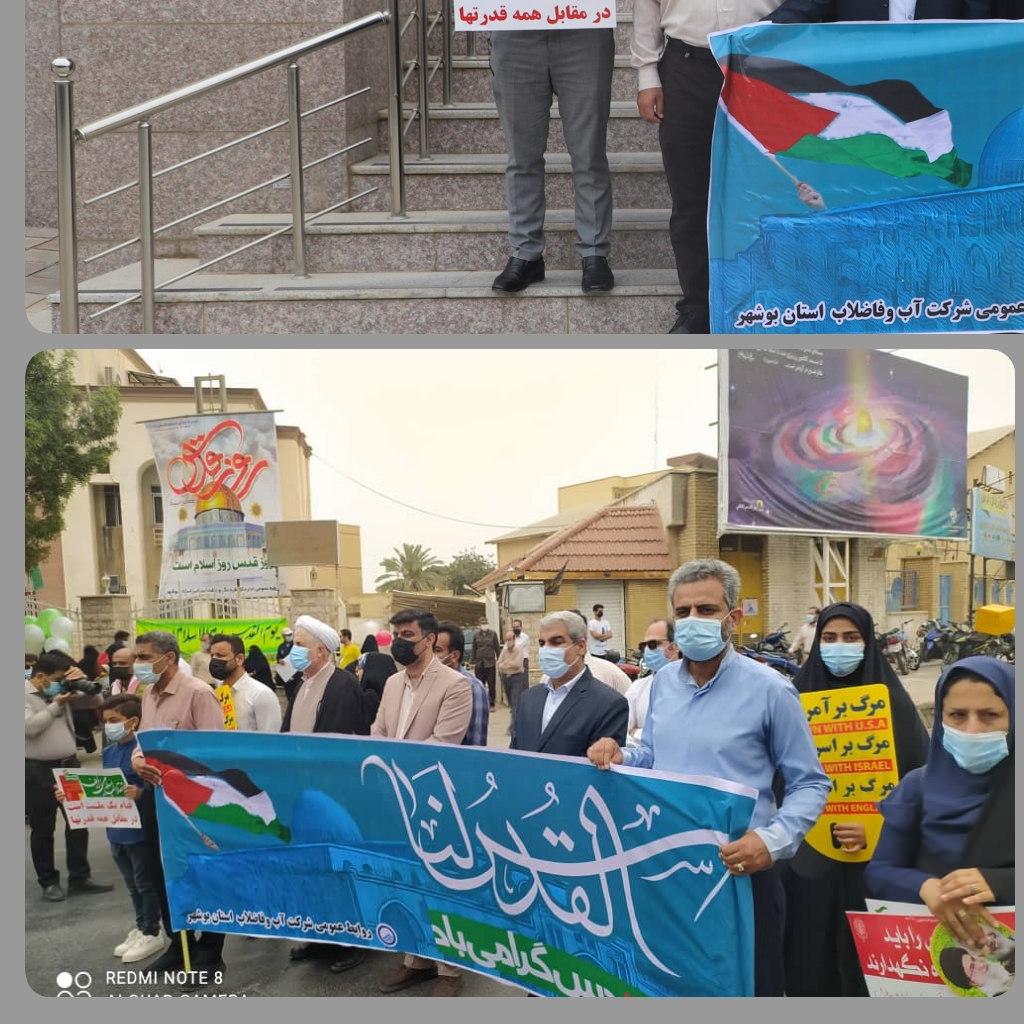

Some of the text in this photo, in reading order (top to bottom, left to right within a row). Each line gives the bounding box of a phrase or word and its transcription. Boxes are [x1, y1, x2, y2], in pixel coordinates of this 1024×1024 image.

[459, 5, 611, 25] در مقابل همه قدرتها
[735, 302, 780, 326] بوشهر
[783, 303, 825, 325] استان
[897, 299, 923, 322] آب
[926, 298, 973, 323] شرکت
[172, 560, 193, 571] است
[194, 558, 216, 574] اسلام
[217, 559, 231, 572] روز
[807, 694, 886, 722] مرگ بر آمر
[823, 722, 852, 733] WITH
[855, 719, 886, 731] U.S.A
[840, 741, 853, 756] بر
[857, 735, 889, 754] مرگ
[825, 760, 890, 773] WITH ISRAEL
[842, 782, 855, 797] بر
[825, 801, 877, 812] WITH ENGL
[186, 909, 212, 925] بوشهر
[212, 909, 233, 925] استان
[273, 913, 285, 930] آب
[287, 915, 314, 931] شرکت
[316, 921, 344, 934] عمومی
[345, 920, 373, 940] روابط
